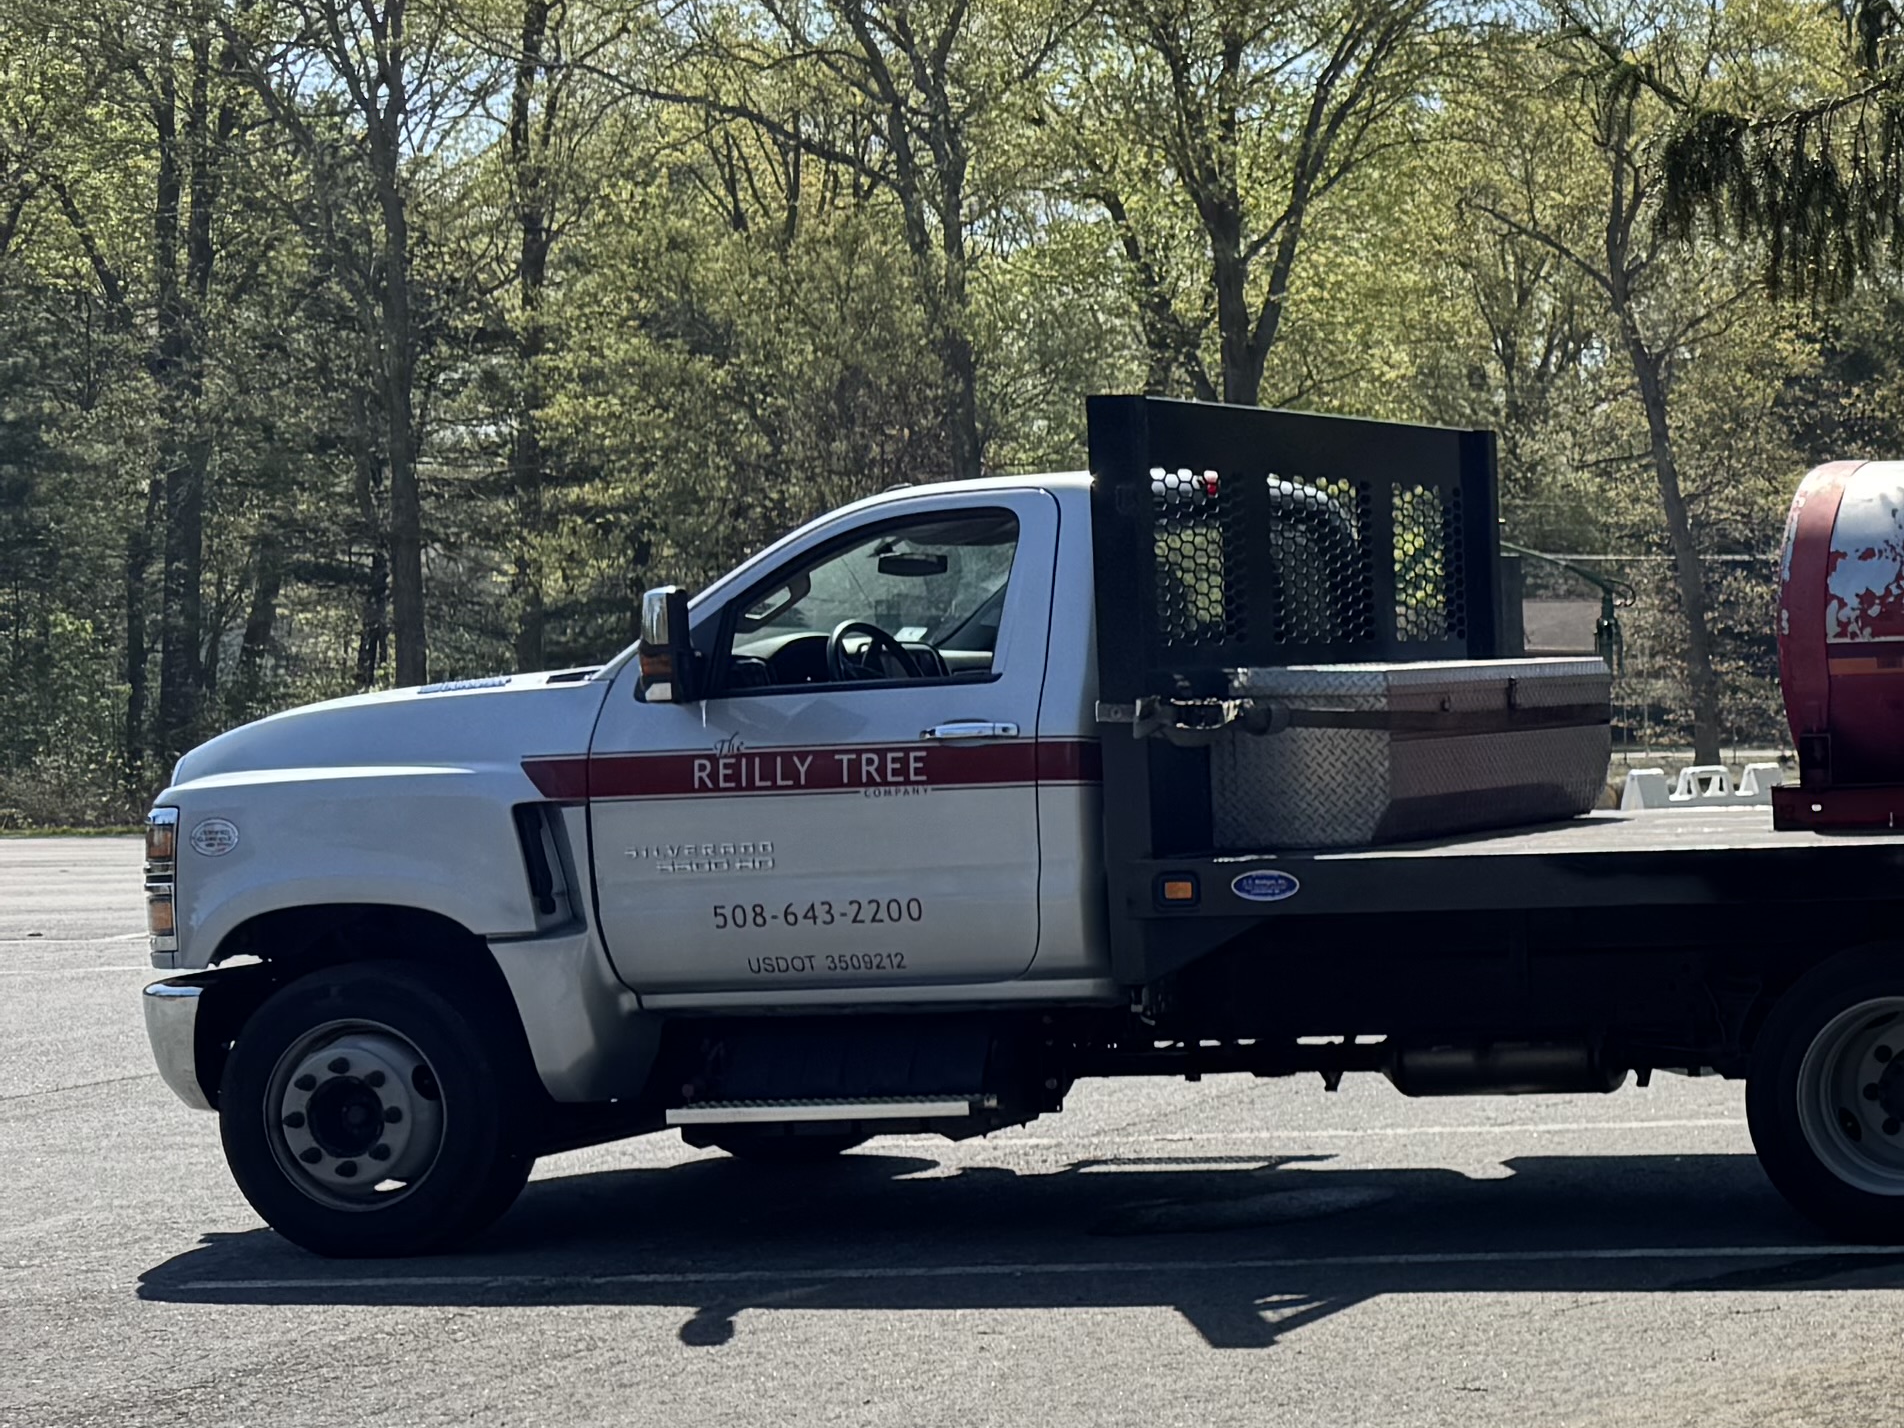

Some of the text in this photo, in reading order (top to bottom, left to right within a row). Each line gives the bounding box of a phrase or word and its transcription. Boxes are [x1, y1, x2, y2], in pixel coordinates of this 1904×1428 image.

[714, 731, 745, 757] The
[693, 751, 927, 788] REILLY TREE
[864, 787, 929, 798] COMPANY
[713, 897, 923, 929] 508-643-2200
[747, 952, 907, 975] USDOT 3509212
